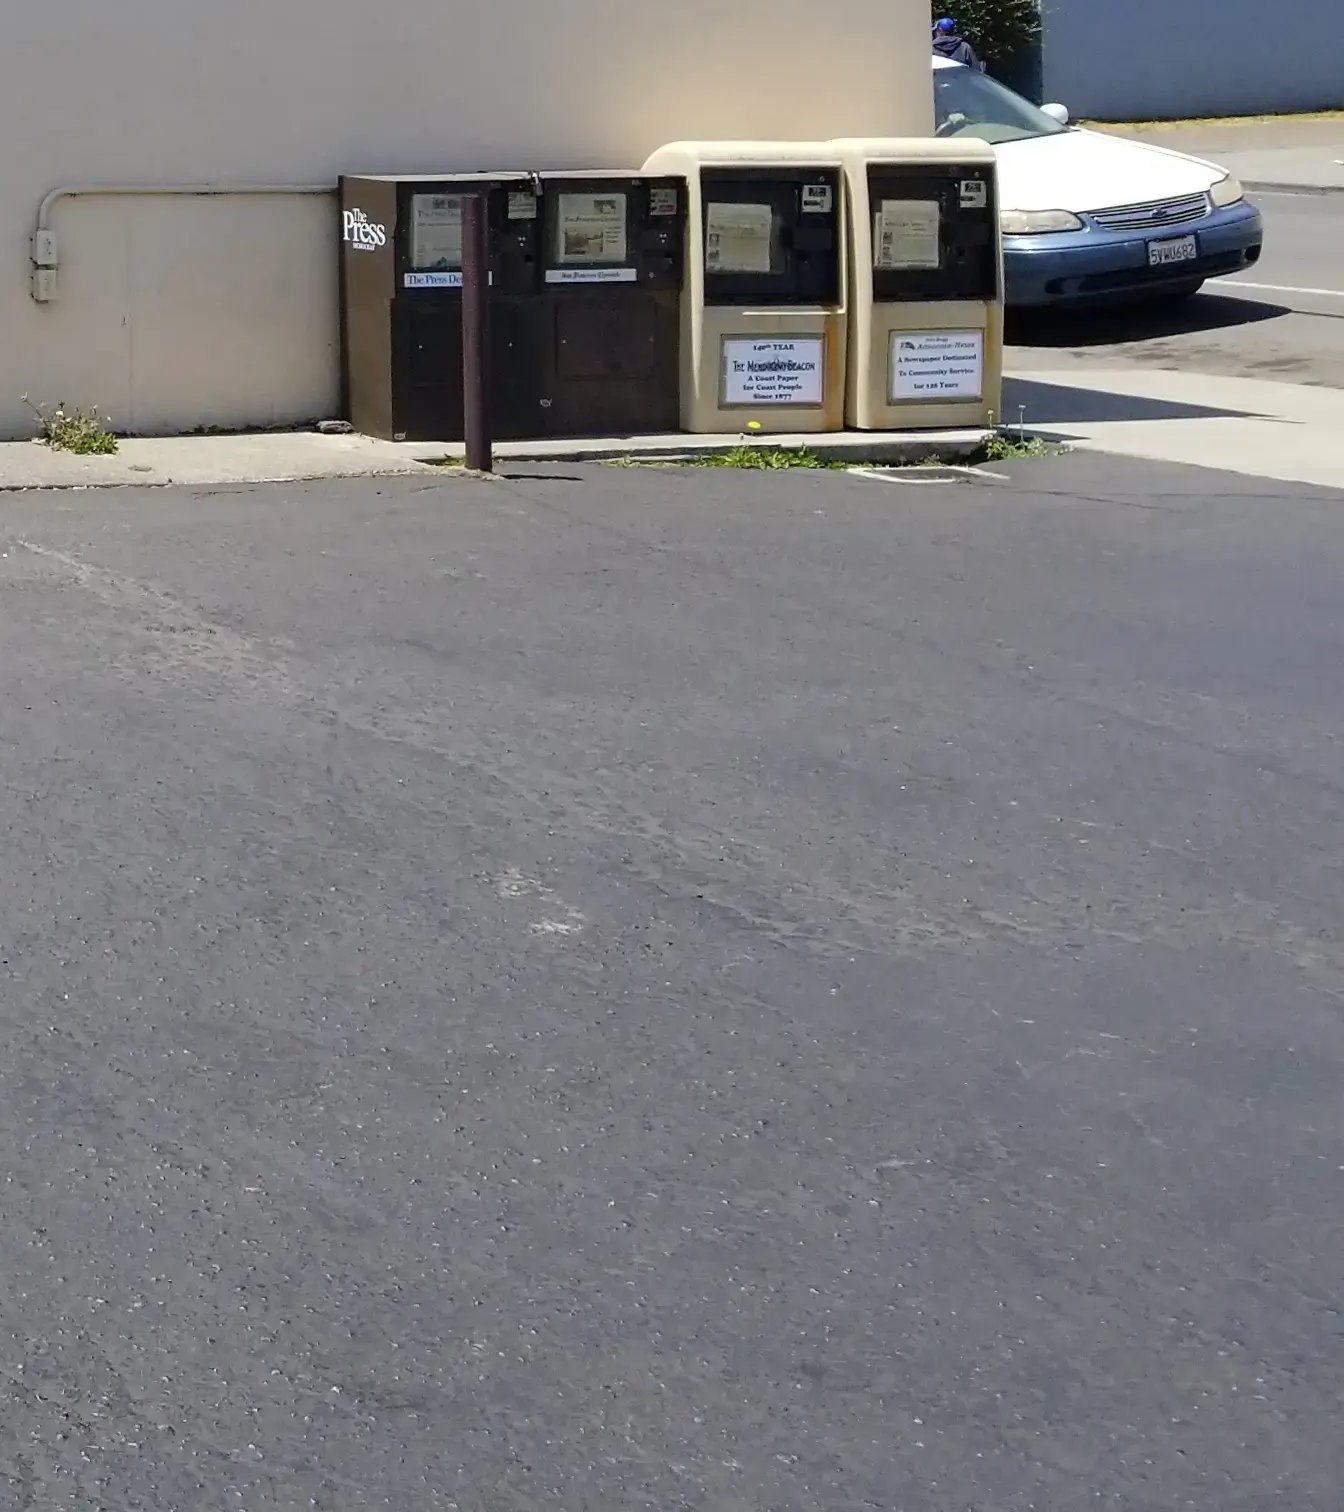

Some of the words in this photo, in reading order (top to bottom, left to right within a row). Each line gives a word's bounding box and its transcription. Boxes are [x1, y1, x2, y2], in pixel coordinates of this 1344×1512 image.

[351, 207, 367, 222] The
[342, 210, 387, 246] Press
[408, 274, 425, 285] The
[425, 274, 448, 285] Press
